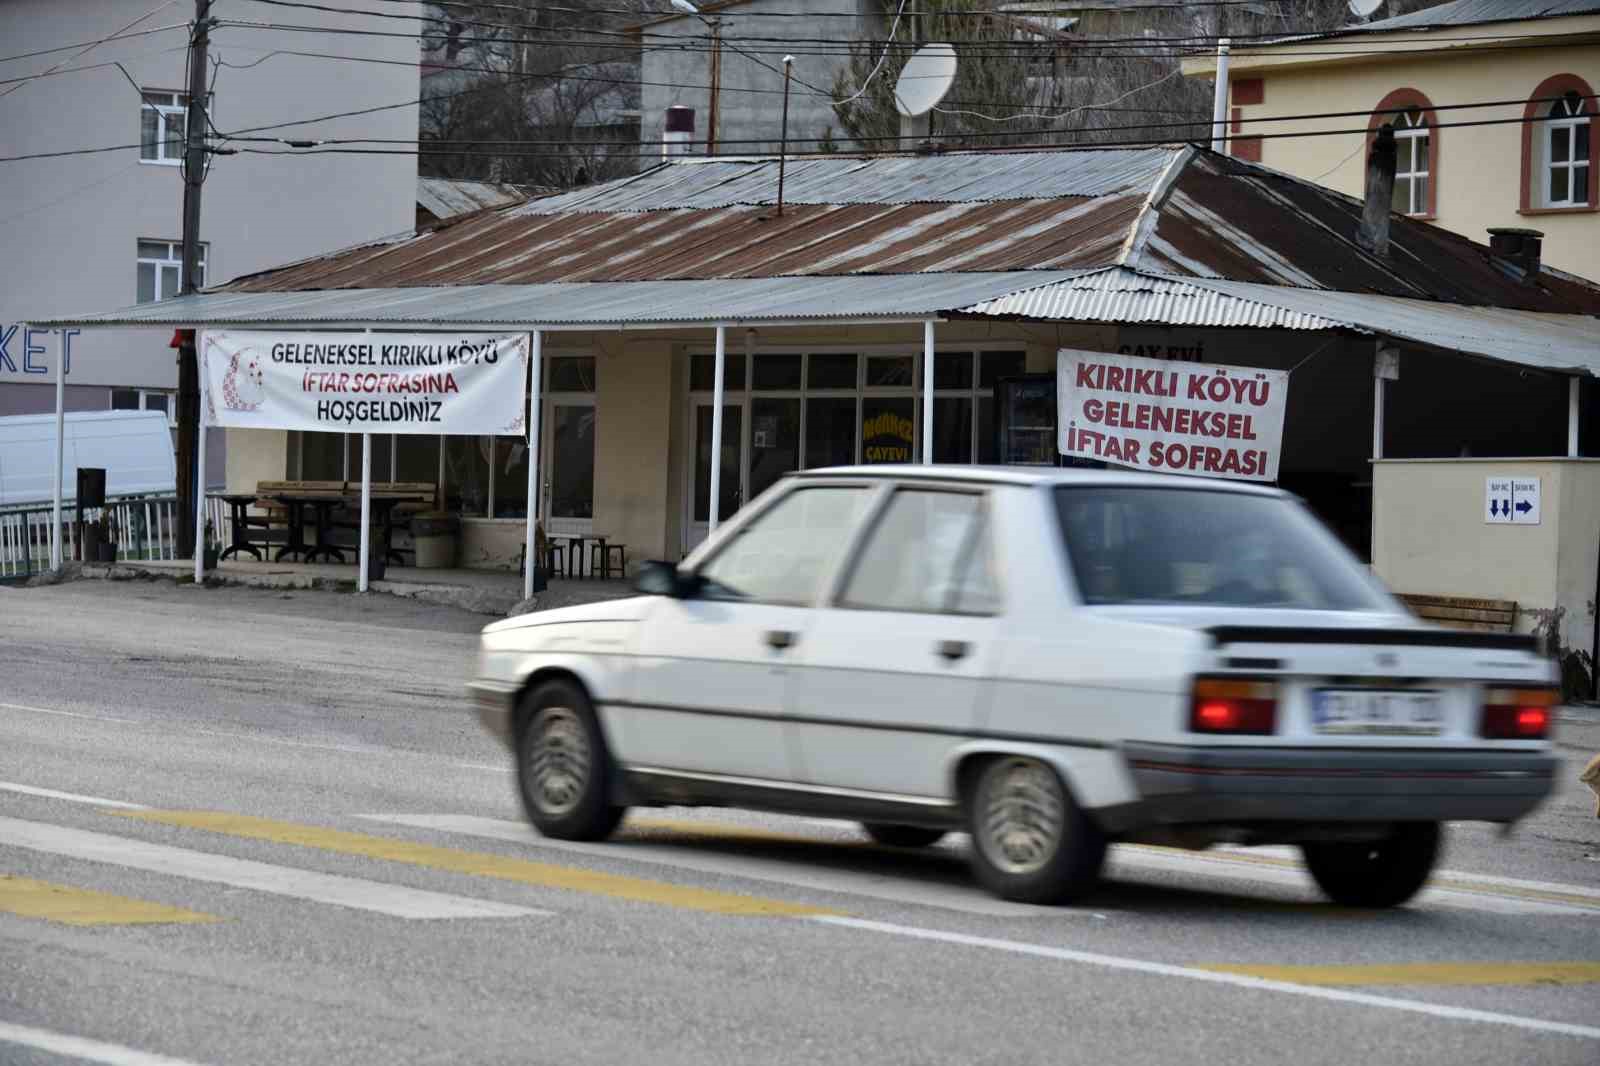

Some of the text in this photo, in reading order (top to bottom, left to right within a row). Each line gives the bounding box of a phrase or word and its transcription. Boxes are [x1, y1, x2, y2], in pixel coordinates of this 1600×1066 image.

[271, 340, 498, 366] GELENEKSEL KIRIKLI KÖYÜ
[303, 367, 459, 394] İFTAR SOFRASINA
[1076, 362, 1270, 406] KIRIKLI KÖYÜ
[317, 396, 442, 425] HOŞGELDİNİZ
[1083, 399, 1257, 441] GELENEKSEL
[1068, 421, 1268, 476] İFTAR SOFRASI
